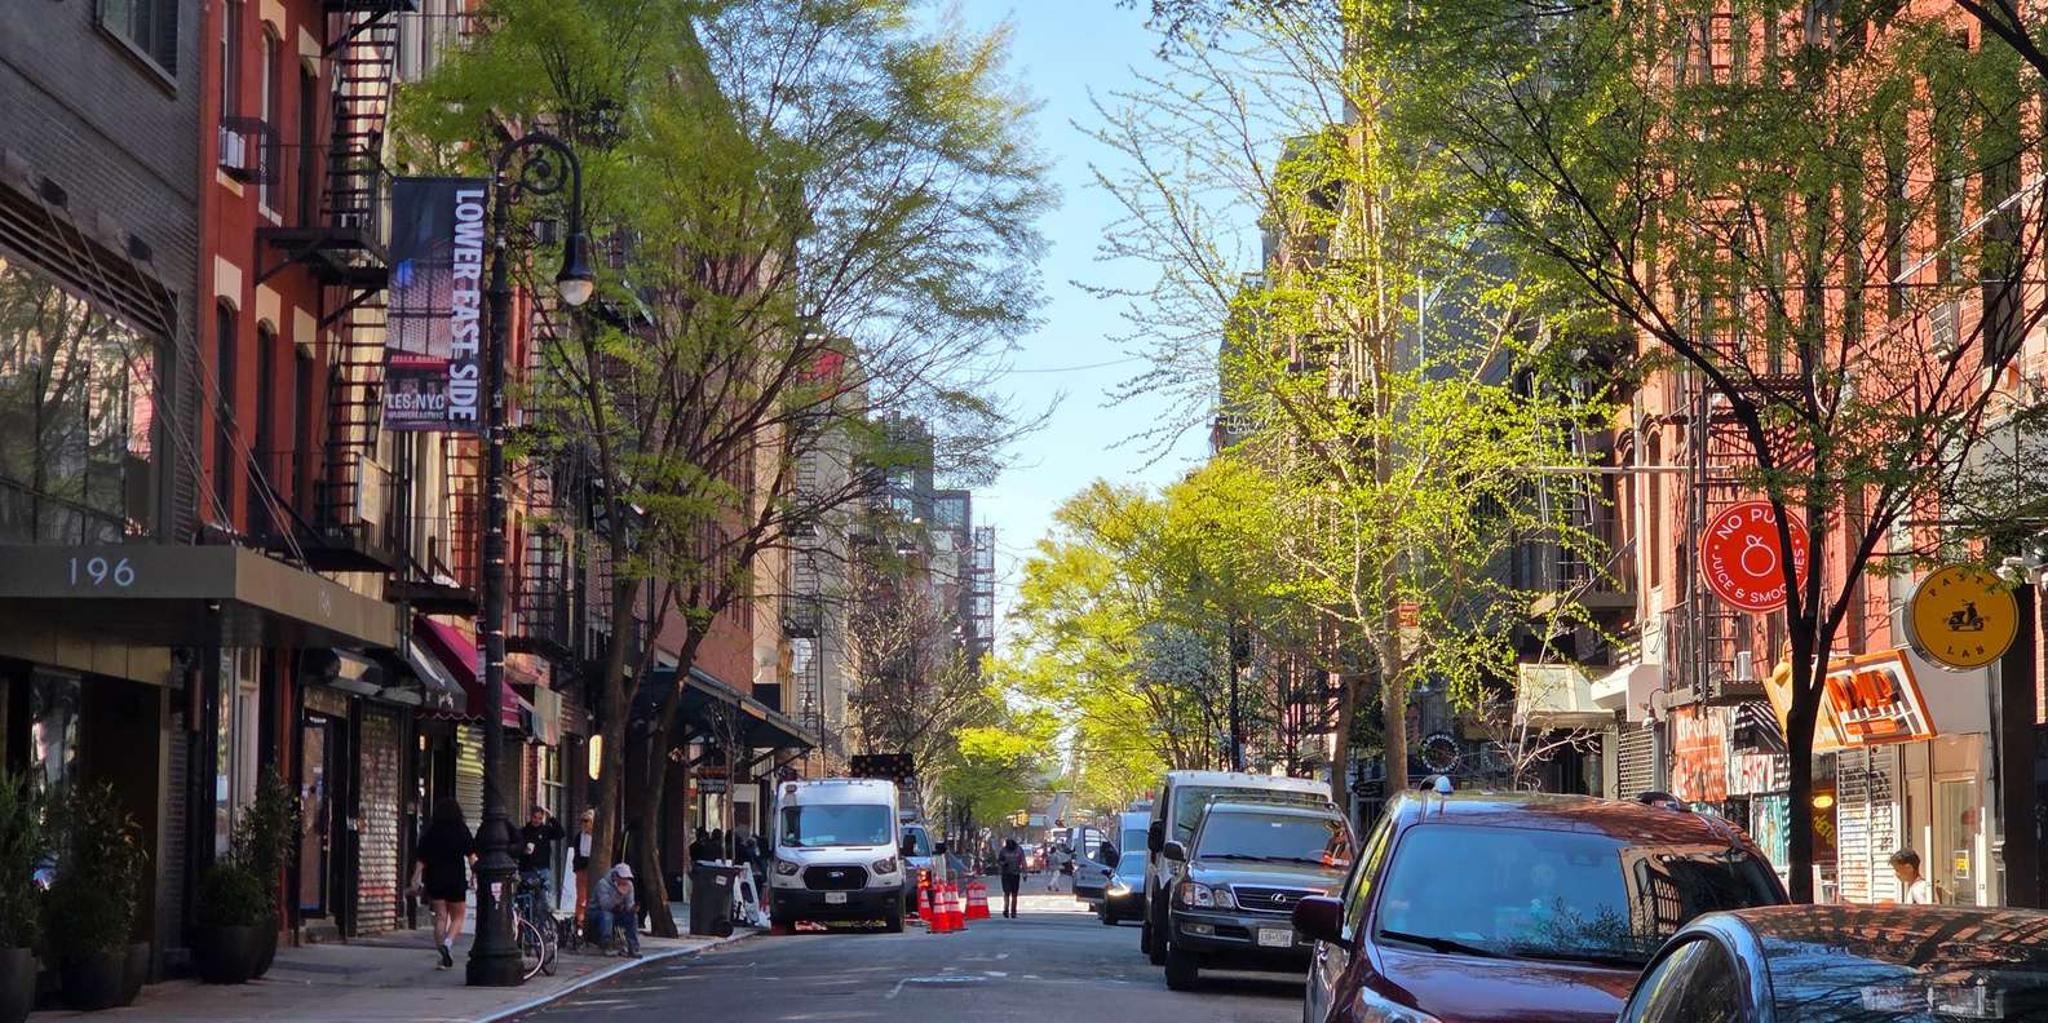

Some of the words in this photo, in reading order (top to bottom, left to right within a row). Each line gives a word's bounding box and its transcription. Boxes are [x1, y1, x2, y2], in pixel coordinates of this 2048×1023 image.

[453, 189, 485, 280] LOWER
[452, 289, 481, 356] EAST
[449, 364, 478, 421] SIDE
[1716, 514, 1743, 541] NO
[69, 557, 135, 587] 196
[1712, 553, 1735, 591] JUICE
[1735, 588, 1746, 599] &
[1946, 645, 1985, 659] LAB
